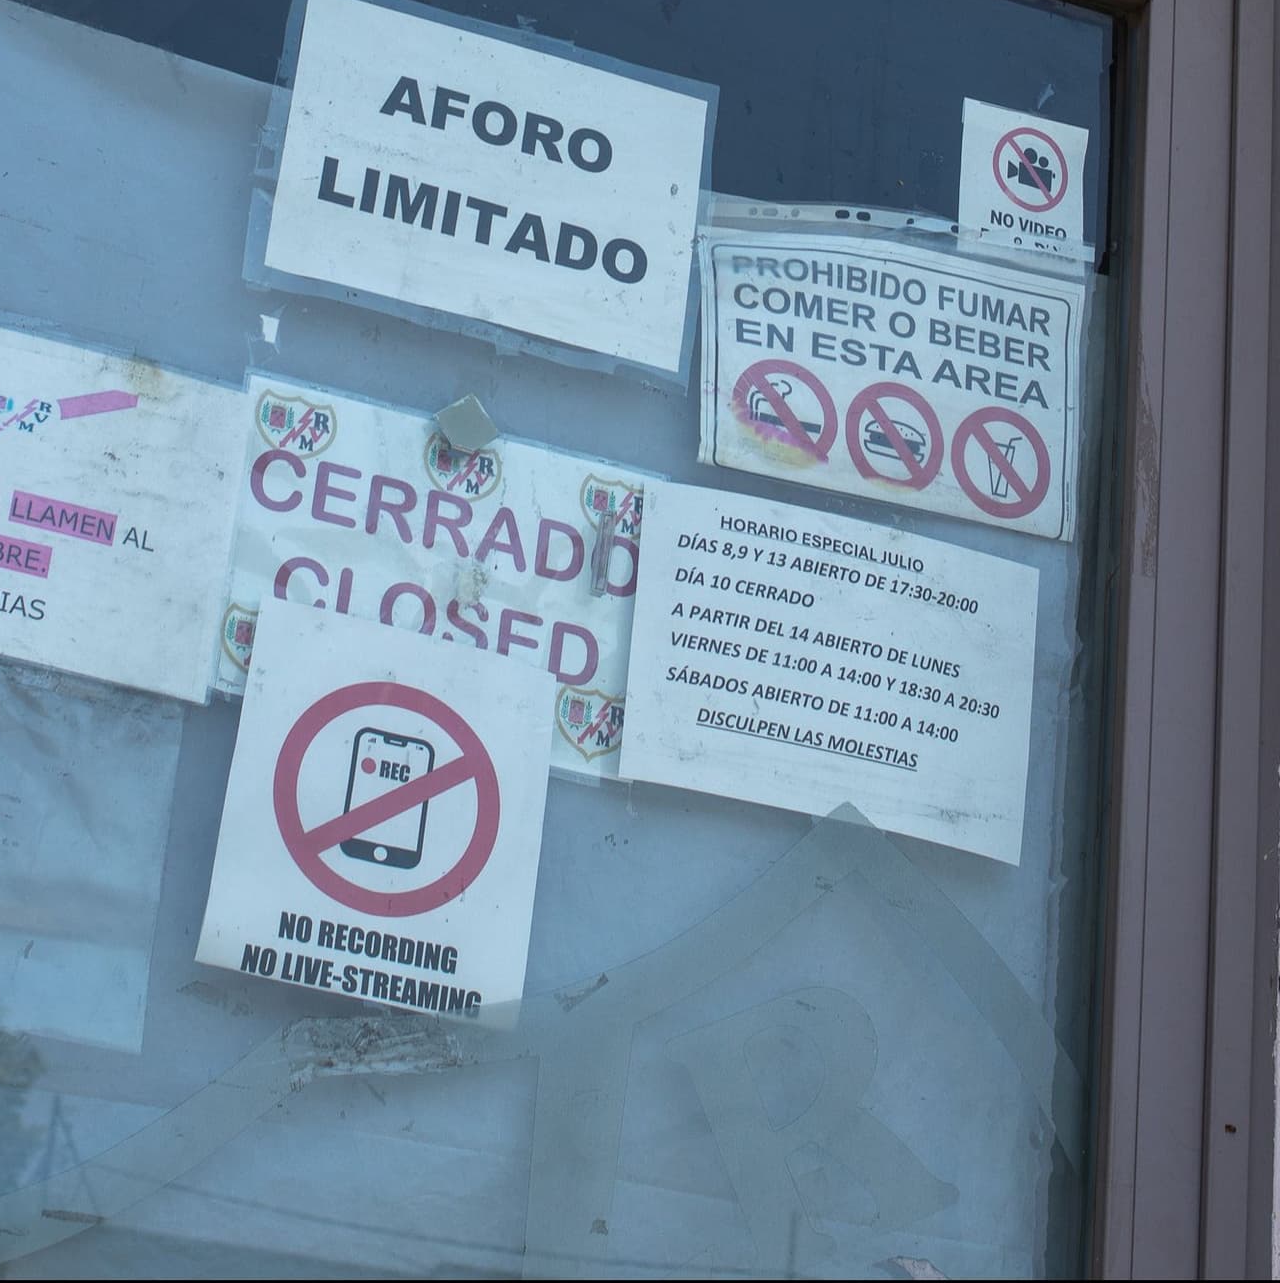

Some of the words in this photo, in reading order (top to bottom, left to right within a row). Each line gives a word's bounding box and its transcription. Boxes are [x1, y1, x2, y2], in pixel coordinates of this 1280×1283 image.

[379, 75, 613, 173] AFORO
[318, 156, 648, 284] LIMITADO
[990, 209, 1014, 228] NO
[1018, 216, 1067, 240] VIDEO
[731, 255, 926, 306] PROHIBIDO
[938, 285, 1051, 337] FUMAR
[733, 283, 875, 333] COMER
[889, 310, 916, 339] O
[929, 316, 1052, 372] BEBER
[735, 318, 795, 353] EN
[811, 331, 922, 380] ESTA
[931, 359, 1050, 410] AREA
[11, 496, 115, 541] LLAMEN
[122, 526, 155, 553] AL
[250, 448, 639, 598] CERRADO
[720, 515, 797, 543] HORARIO
[801, 532, 878, 563] ESPECIAL
[880, 550, 925, 574] JULIO
[675, 568, 705, 587] DÍA
[710, 575, 731, 592] 10
[735, 580, 816, 608] CERRADO
[677, 532, 718, 554] DÍAS
[722, 542, 749, 561] 8,9
[752, 547, 763, 562] Y
[767, 550, 787, 568] 13
[790, 556, 861, 585] ABIERTO
[865, 573, 886, 590] DE
[889, 579, 979, 615] 17:30-20:00
[670, 631, 741, 659] VIERNES
[745, 646, 768, 664] DE
[772, 652, 818, 675] 11:00
[820, 662, 834, 677] A
[836, 667, 882, 689] 14:00
[885, 678, 897, 693] Y
[898, 681, 942, 704] 18:30
[944, 692, 957, 708] A
[958, 696, 1001, 720] 20:30
[671, 602, 685, 617] A
[689, 605, 752, 630] PARTIR
[755, 618, 785, 637] DEL
[788, 626, 810, 642] 14
[812, 631, 883, 659] ABIERTO
[887, 647, 909, 665] DE
[911, 653, 961, 679] LUNES
[665, 666, 749, 695] SÁBADOS
[751, 683, 825, 712] ABIERTO
[828, 700, 852, 718] DE
[854, 705, 898, 728] 11:00
[901, 717, 914, 732] A
[916, 721, 959, 744] 14:00
[696, 707, 791, 741] DISCULPEN
[794, 727, 824, 747] LAS
[827, 734, 919, 769] MOLESTIAS
[379, 759, 411, 783] REC
[240, 944, 278, 977] NO
[280, 953, 482, 1017] LIVE-STREAMING
[278, 911, 312, 943] NO
[318, 921, 458, 974] RECORDING
